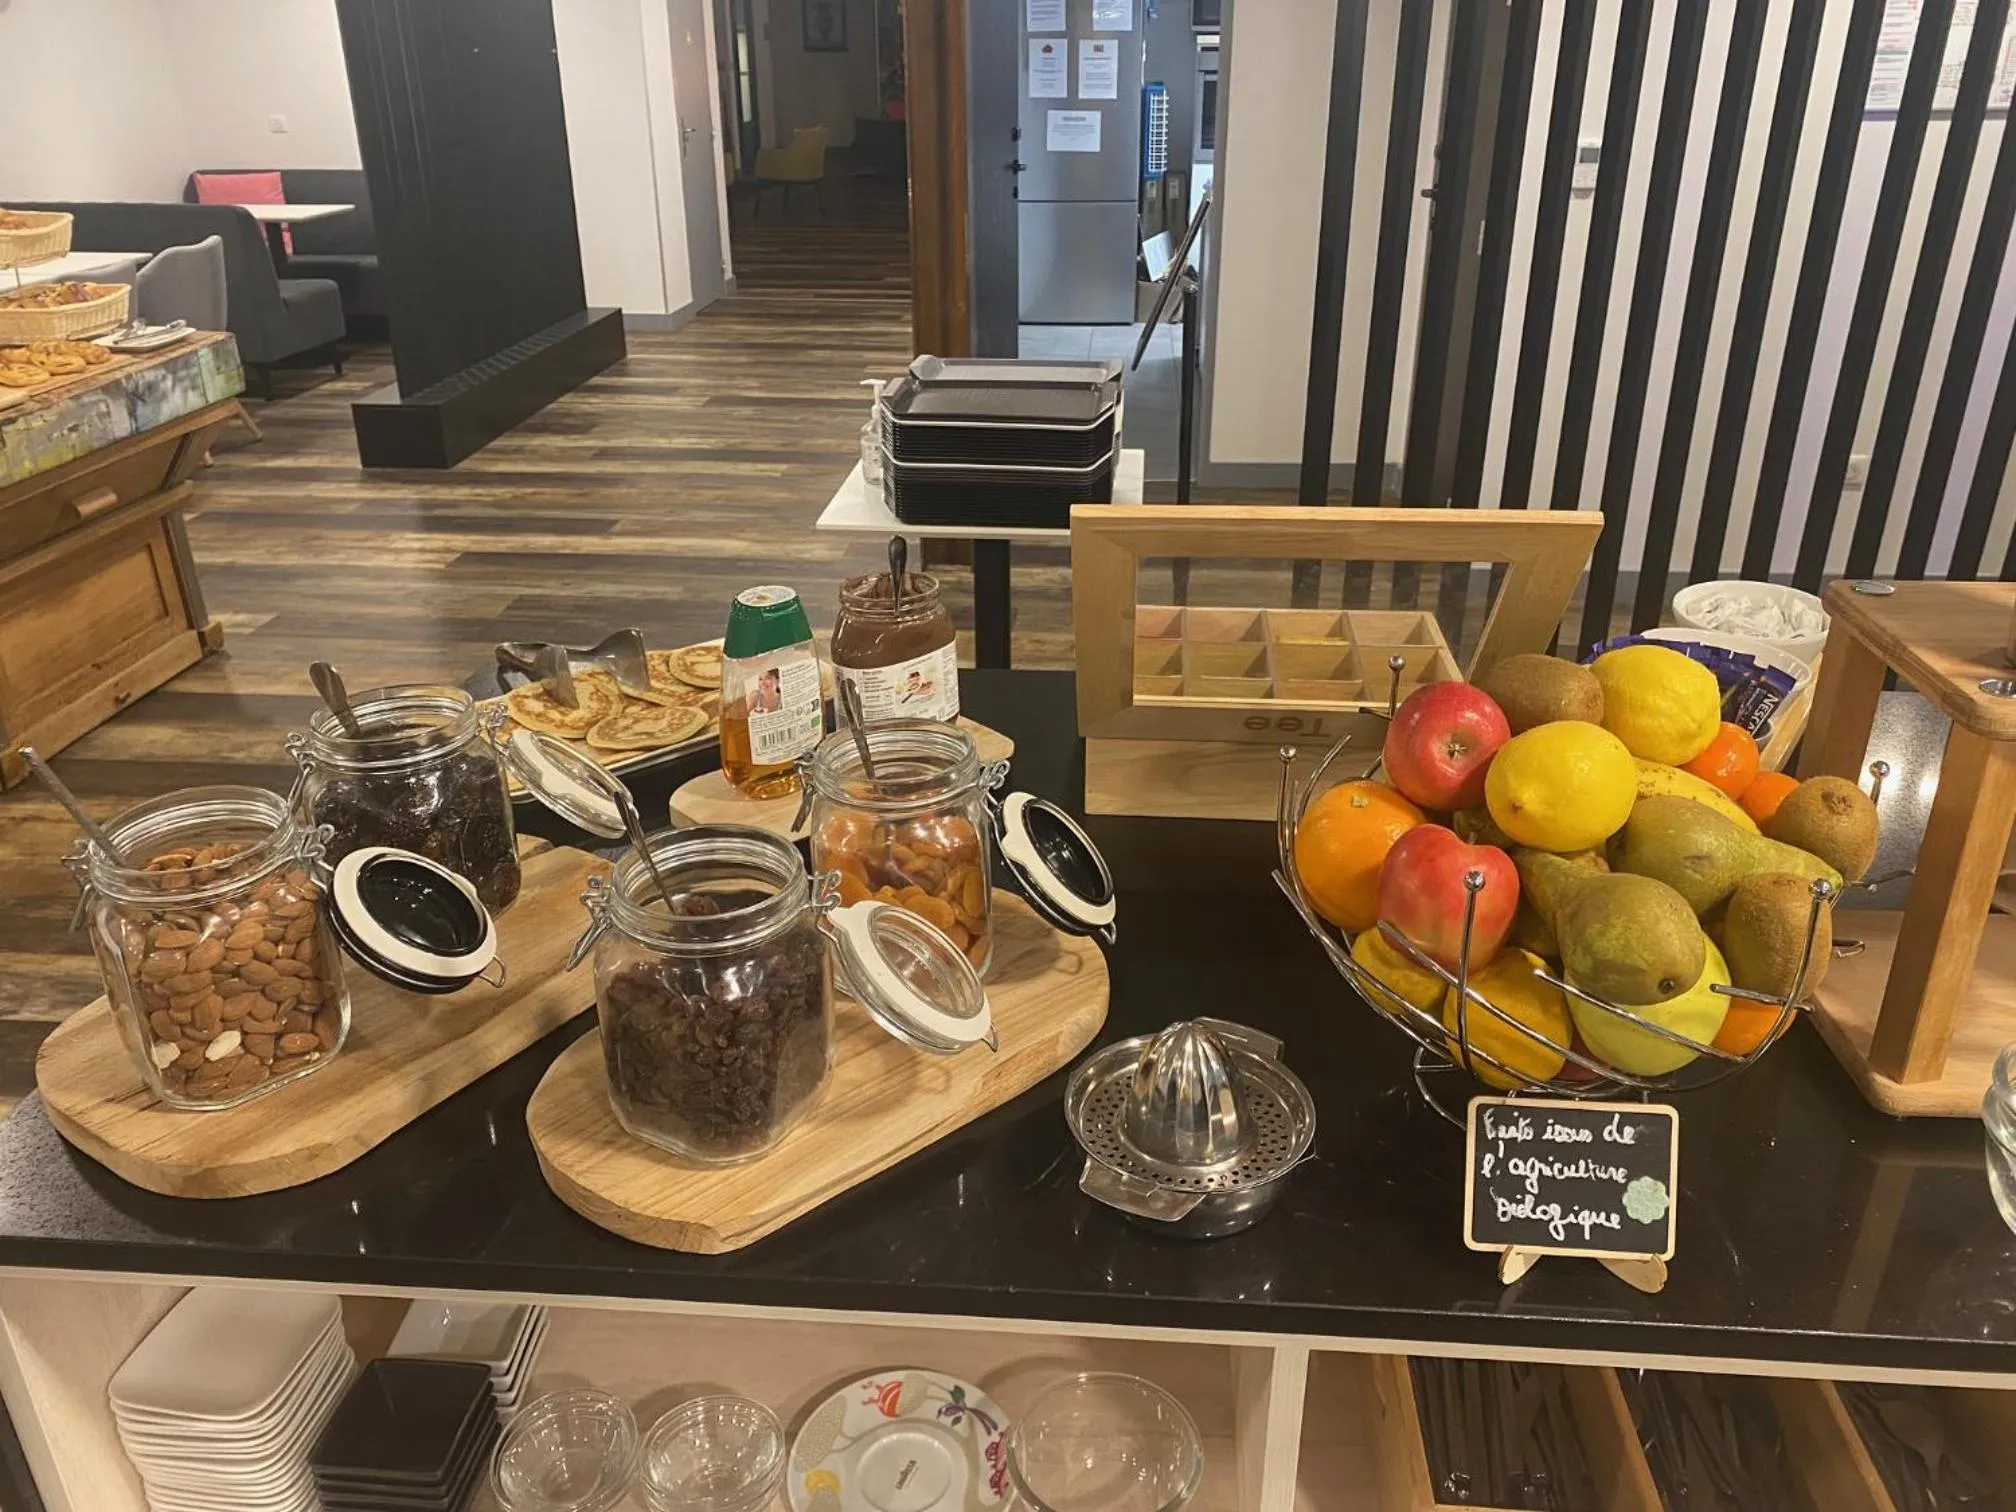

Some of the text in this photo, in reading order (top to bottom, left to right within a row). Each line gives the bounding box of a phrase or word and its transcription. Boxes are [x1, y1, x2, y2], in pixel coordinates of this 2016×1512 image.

[1243, 716, 1331, 737] Tee
[1748, 693, 1779, 733] NESCA
[1542, 1119, 1593, 1143] issus
[1603, 1113, 1635, 1144] de
